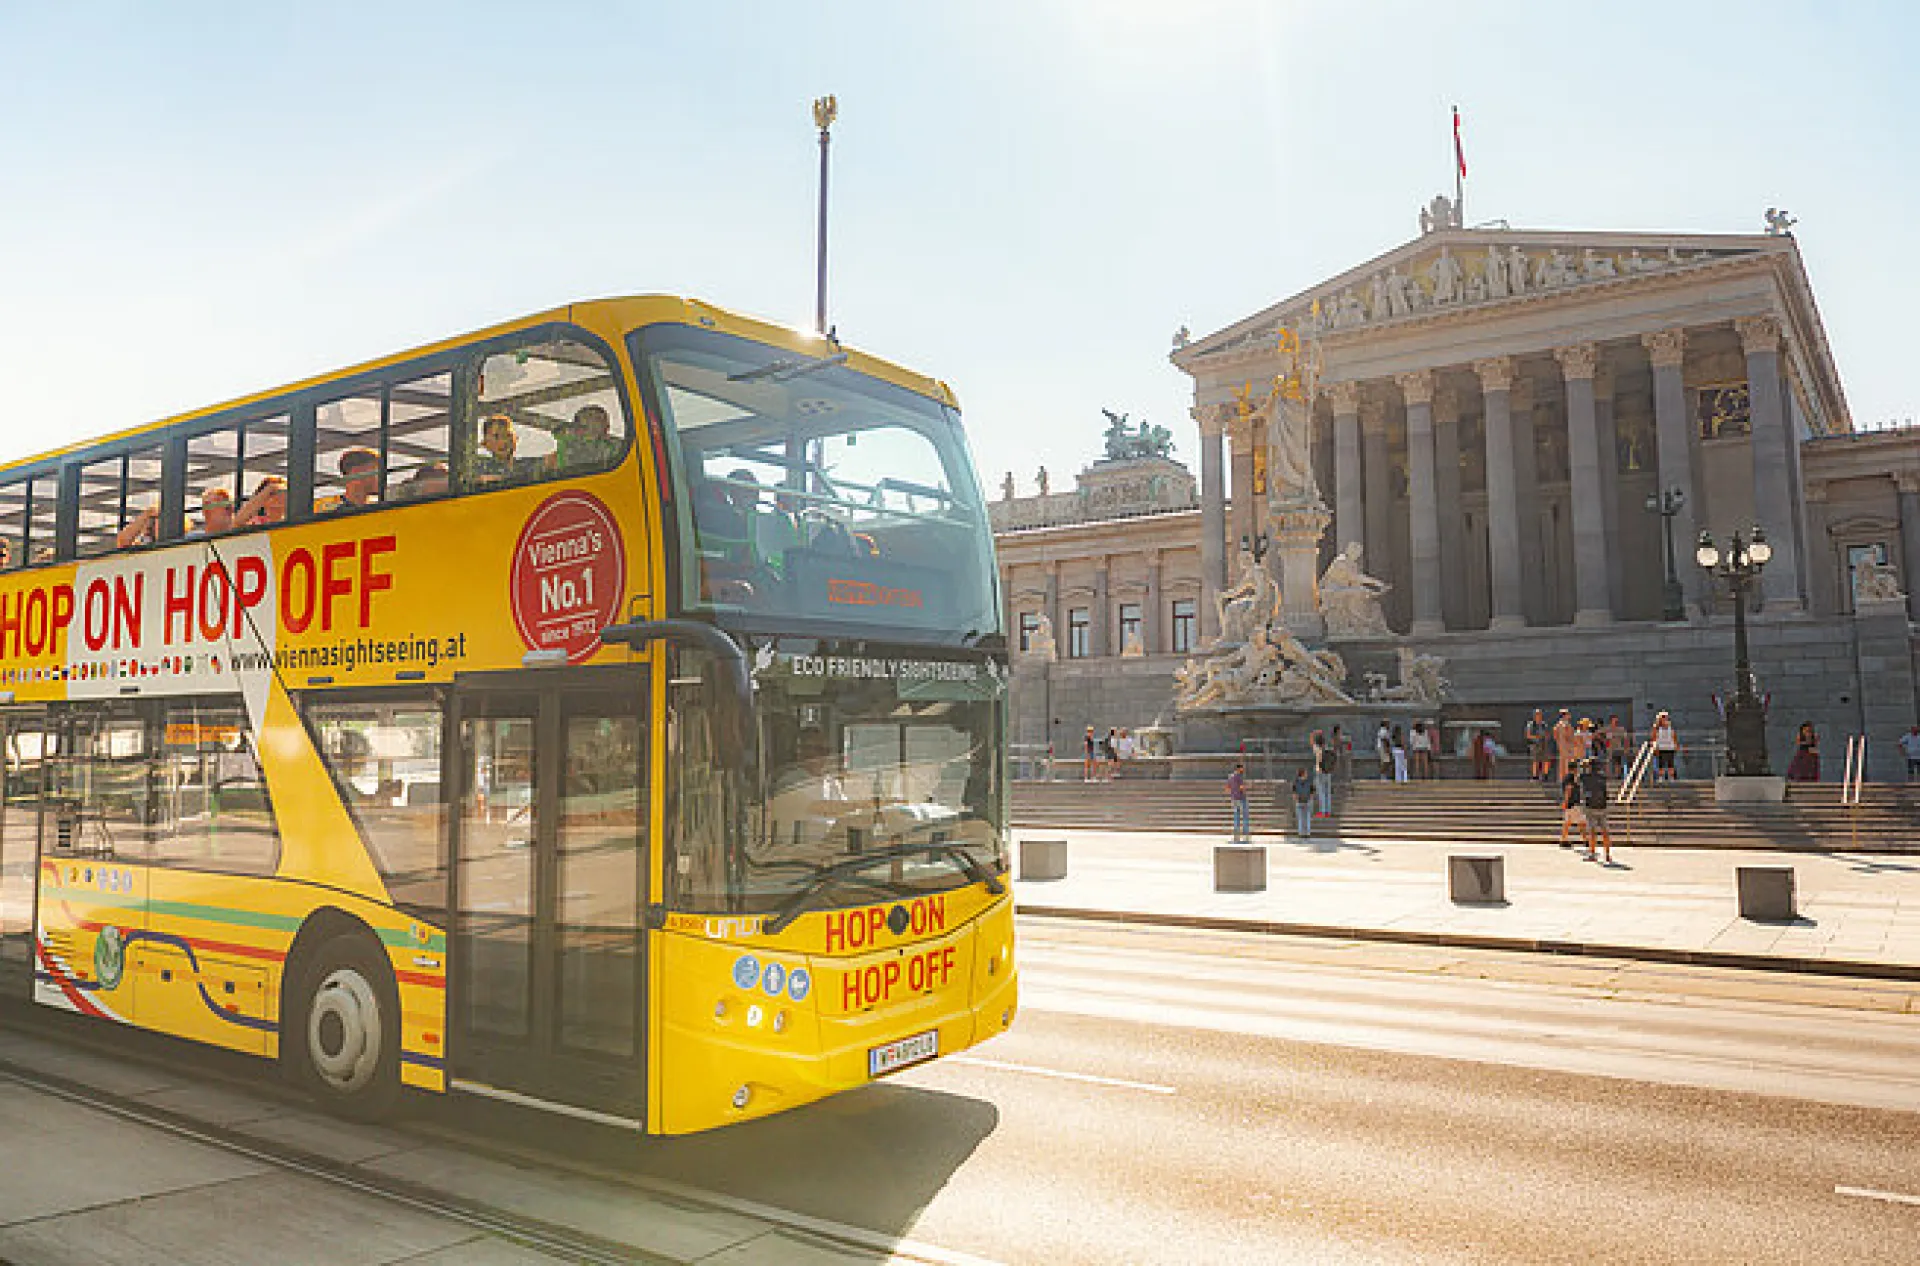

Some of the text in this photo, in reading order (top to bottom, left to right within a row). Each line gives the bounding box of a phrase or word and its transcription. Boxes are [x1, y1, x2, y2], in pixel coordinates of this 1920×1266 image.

[528, 530, 602, 566] Vienna's
[0, 535, 397, 660] HOP ON HOP OFF
[541, 567, 594, 614] No.1
[231, 633, 467, 672] www.viennasightseeing.at
[793, 655, 825, 675] ECO
[827, 656, 898, 679] FRIENDLY
[825, 896, 946, 954] HOP ON
[843, 946, 956, 1012] HOP OFF
